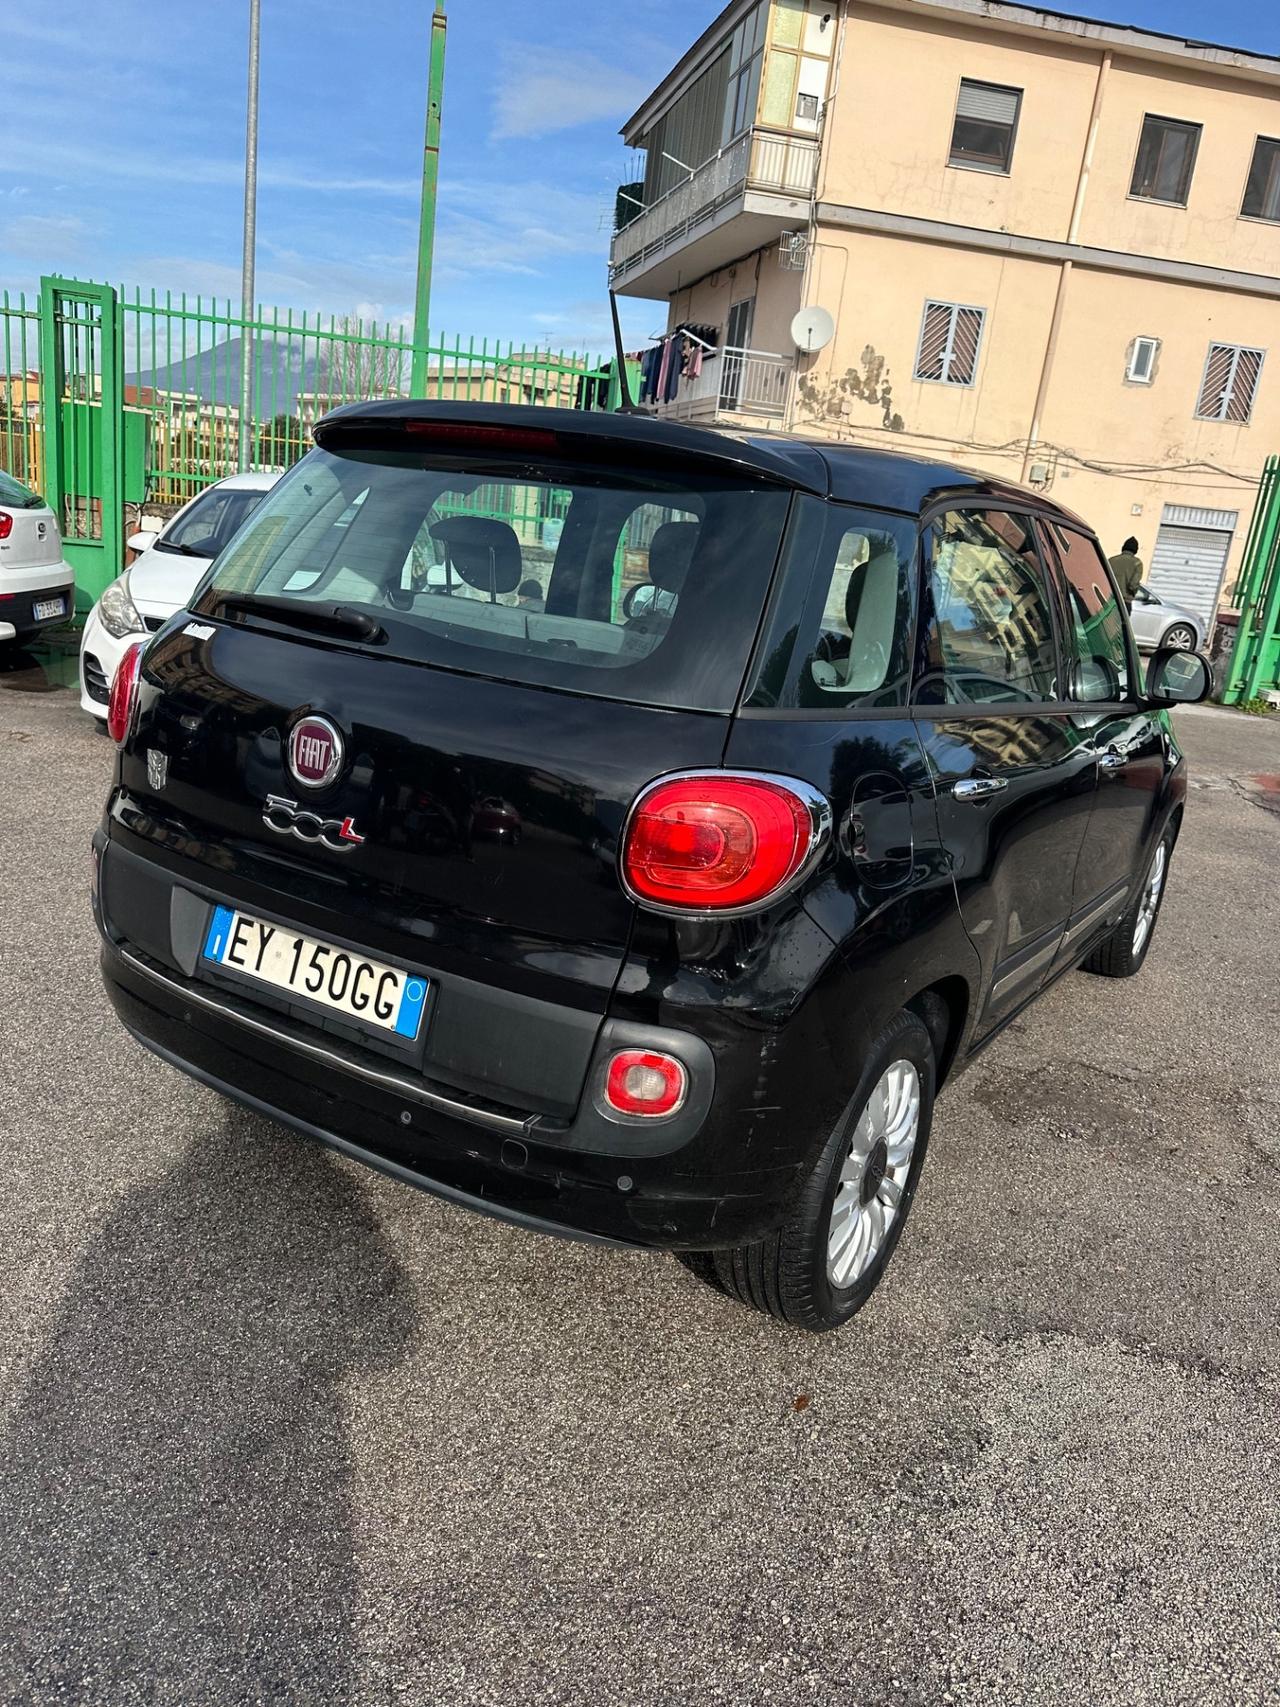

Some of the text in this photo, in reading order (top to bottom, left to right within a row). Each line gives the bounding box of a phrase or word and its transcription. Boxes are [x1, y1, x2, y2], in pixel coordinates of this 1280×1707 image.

[297, 735, 330, 771] FIAT
[262, 793, 366, 852] 500L
[227, 915, 399, 1020] EY 150GG
